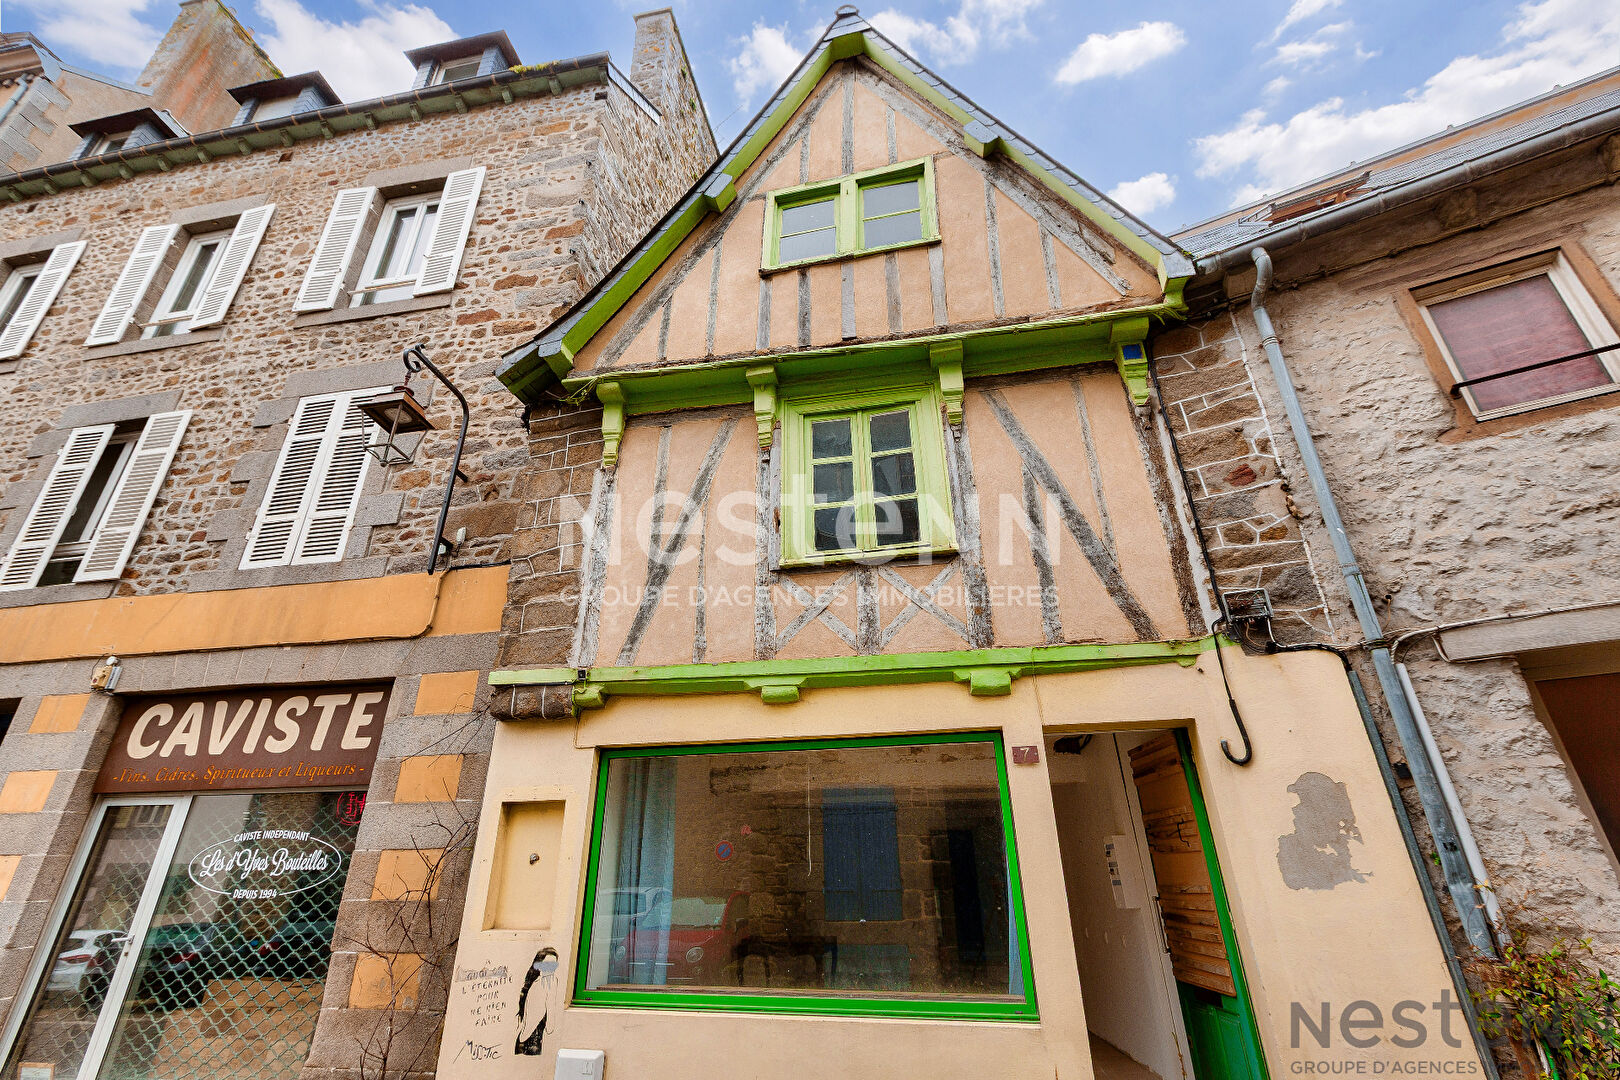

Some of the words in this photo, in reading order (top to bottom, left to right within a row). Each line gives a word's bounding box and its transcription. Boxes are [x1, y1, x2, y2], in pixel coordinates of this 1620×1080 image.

[126, 691, 385, 760] CAVISTE
[1020, 747, 1030, 762] 7
[203, 764, 276, 785] Spiritueux
[278, 766, 292, 778] et
[295, 761, 356, 782] Liqueurs
[234, 830, 262, 843] CAVISTE
[262, 830, 311, 842] INDEPENDANT
[200, 849, 225, 877] Les
[270, 847, 328, 877] Bouteilles
[233, 889, 258, 899] DEPUIS
[259, 889, 278, 899] 1994
